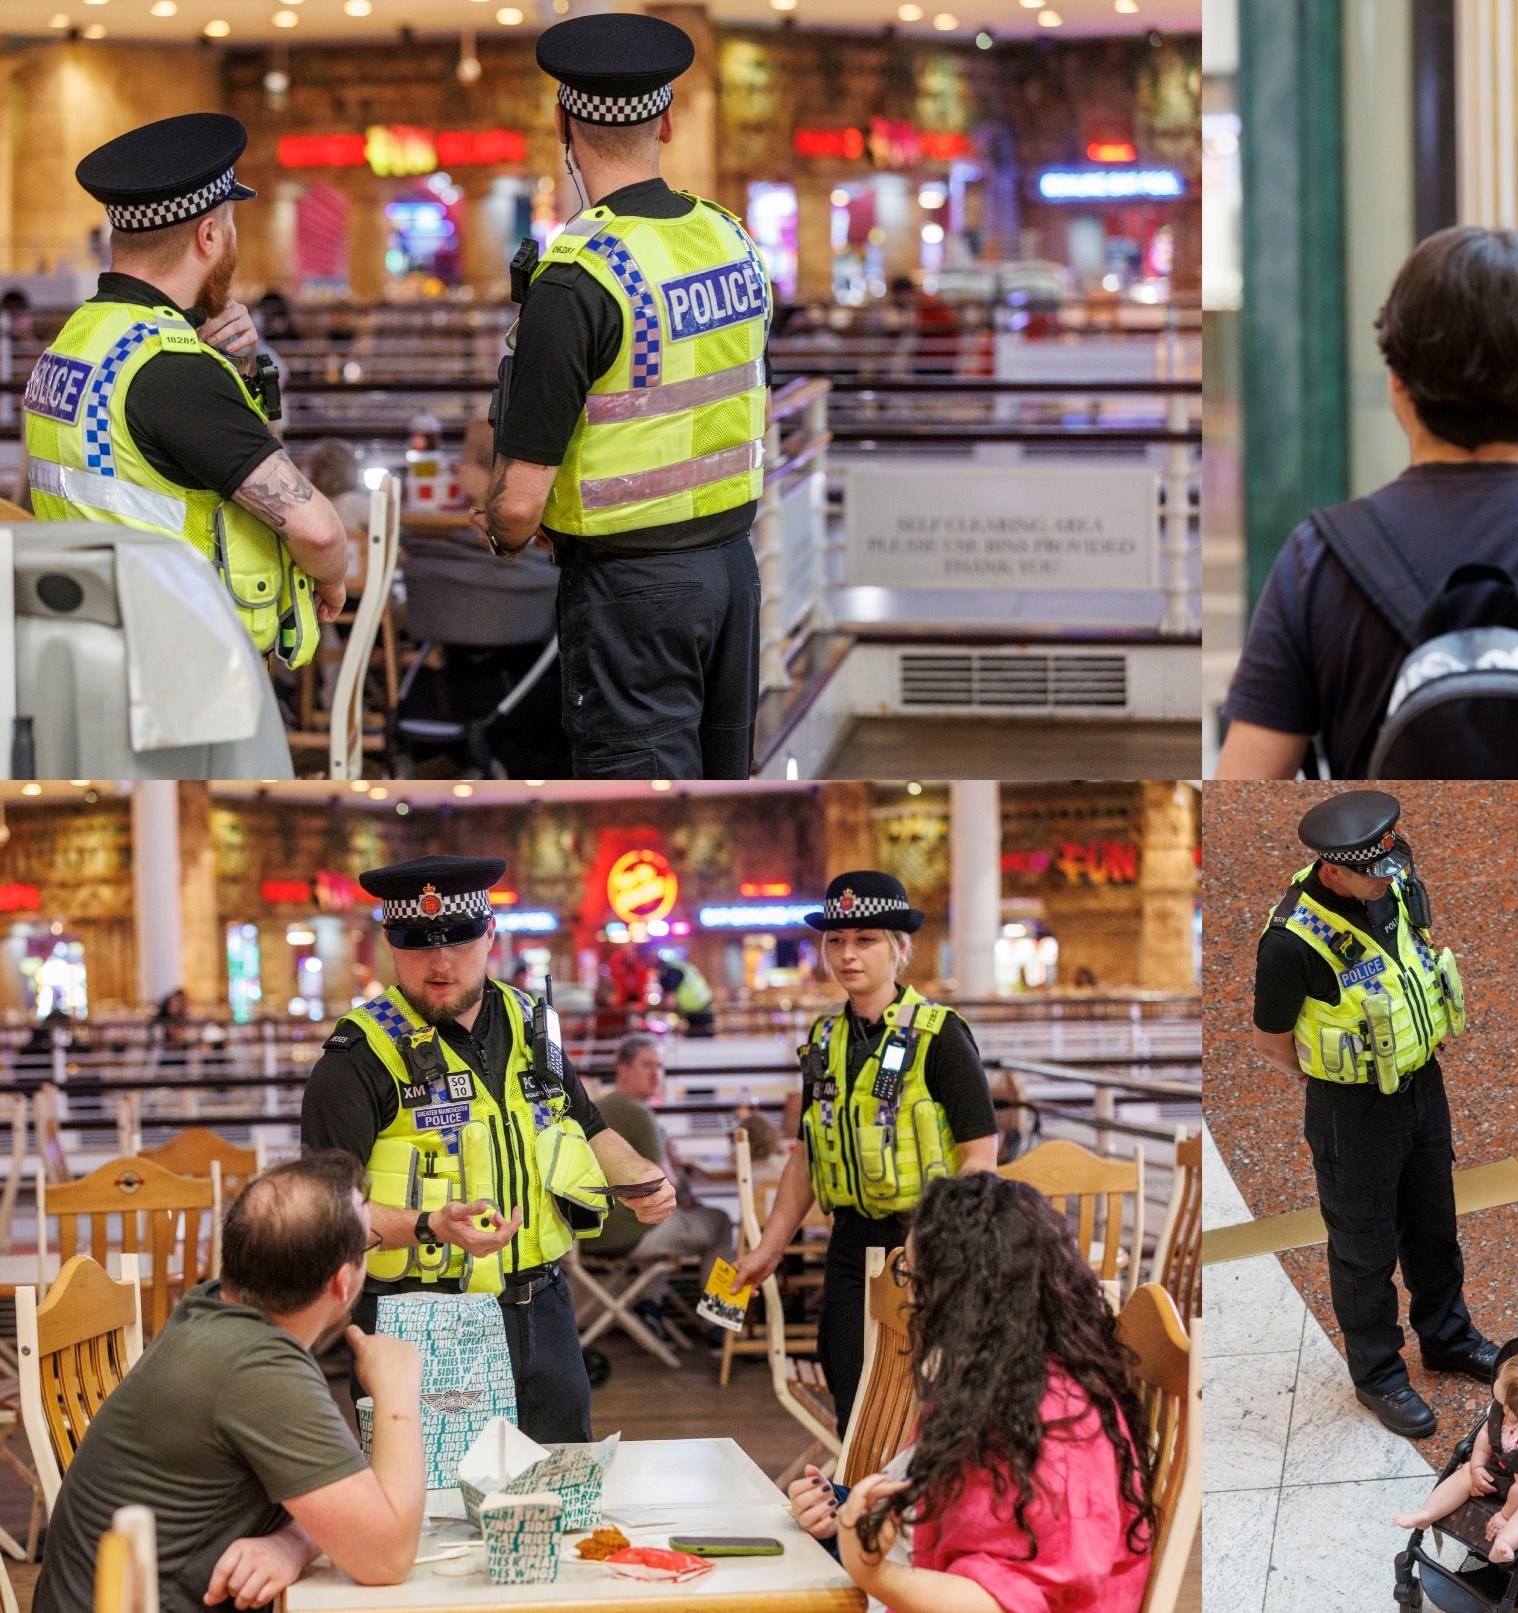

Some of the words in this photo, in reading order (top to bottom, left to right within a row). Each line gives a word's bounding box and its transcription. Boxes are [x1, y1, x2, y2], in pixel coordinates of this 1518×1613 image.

[668, 268, 762, 331] POLICE
[166, 336, 197, 345] 18285
[27, 362, 84, 413] OLICE
[1384, 916, 1400, 934] POLI
[1341, 958, 1384, 987] POLICE
[451, 1076, 466, 1087] SO
[523, 1076, 536, 1089] PC
[404, 1084, 426, 1099] XM
[454, 1086, 467, 1097] 10
[416, 1109, 437, 1118] GREATER
[438, 1105, 469, 1115] MANCHESTER
[425, 1113, 462, 1127] POLICE
[398, 1313, 430, 1321] WINGS
[401, 1321, 428, 1330] FRIES
[460, 1346, 483, 1356] WINGS
[437, 1357, 459, 1367] FRIES
[437, 1366, 460, 1376] SIDES
[432, 1375, 465, 1386] REPEAT
[445, 1413, 469, 1424] FRIES
[444, 1422, 469, 1433] SIDES
[440, 1431, 466, 1442] FRIES
[440, 1441, 466, 1452] SIDES
